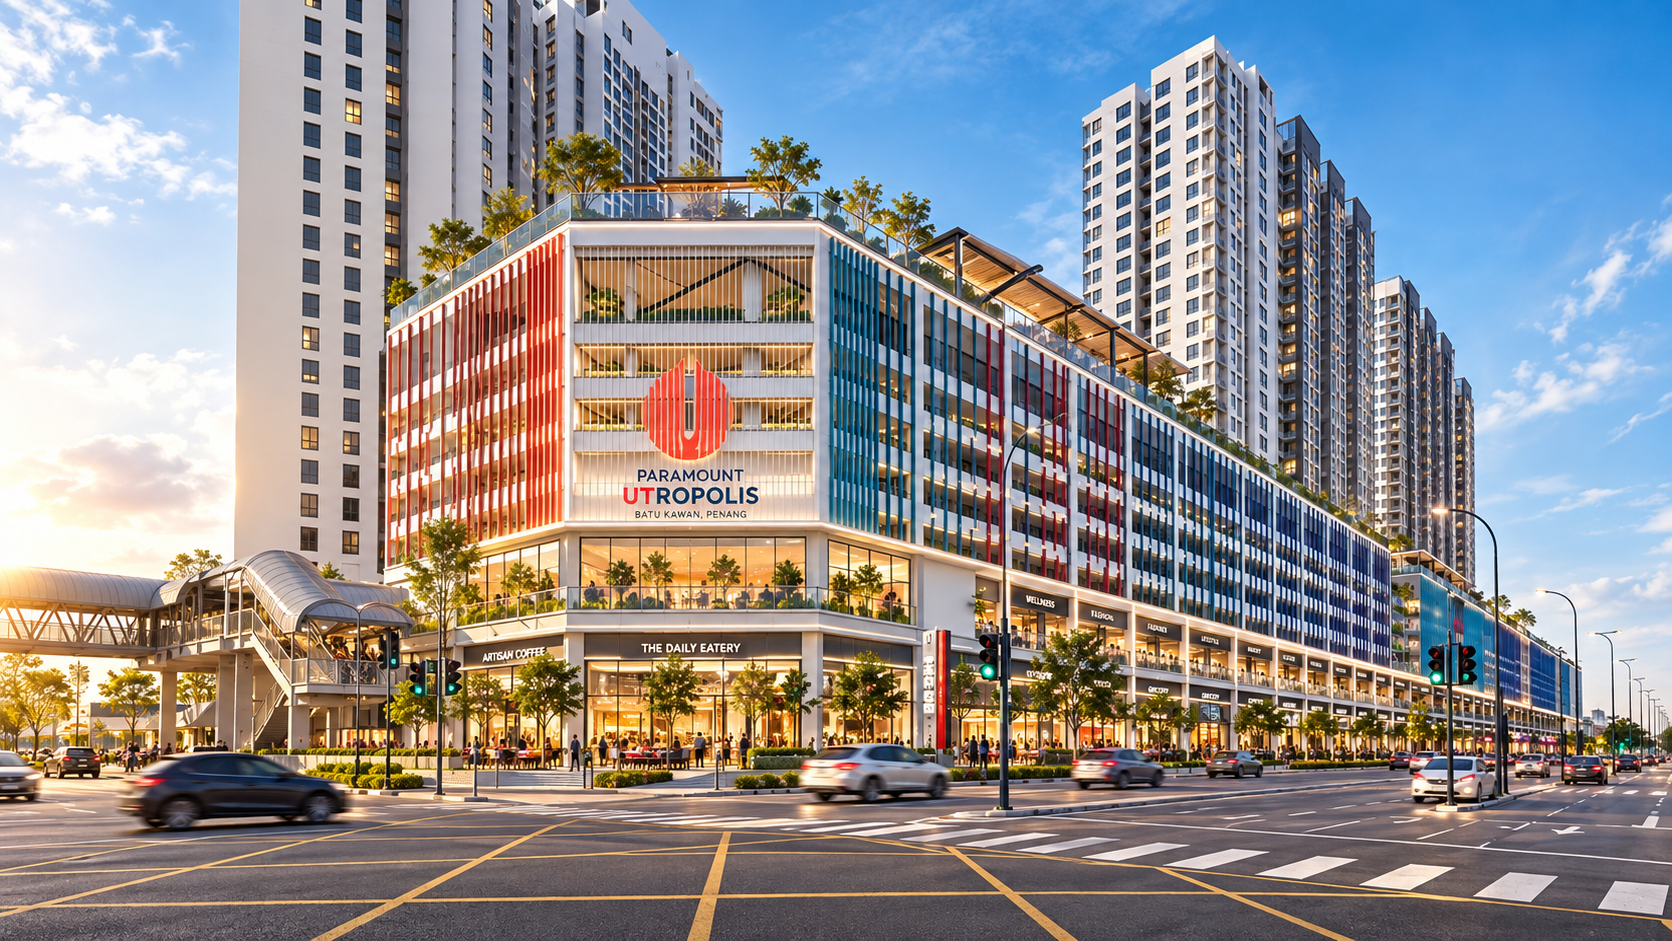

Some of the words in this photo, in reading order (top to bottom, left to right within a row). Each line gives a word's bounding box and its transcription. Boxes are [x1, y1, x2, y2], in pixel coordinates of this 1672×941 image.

[637, 469, 744, 482] PARAMOUNT
[623, 486, 759, 505] UTROPOLIS
[635, 510, 660, 519] BATU
[664, 510, 703, 520] KAWAN,
[706, 510, 747, 519] PENANG
[482, 650, 514, 663] ARTISAN
[515, 646, 546, 660] COFFEE
[641, 643, 663, 653] THE
[665, 643, 698, 653] DAILY
[700, 643, 741, 653] EATERY
